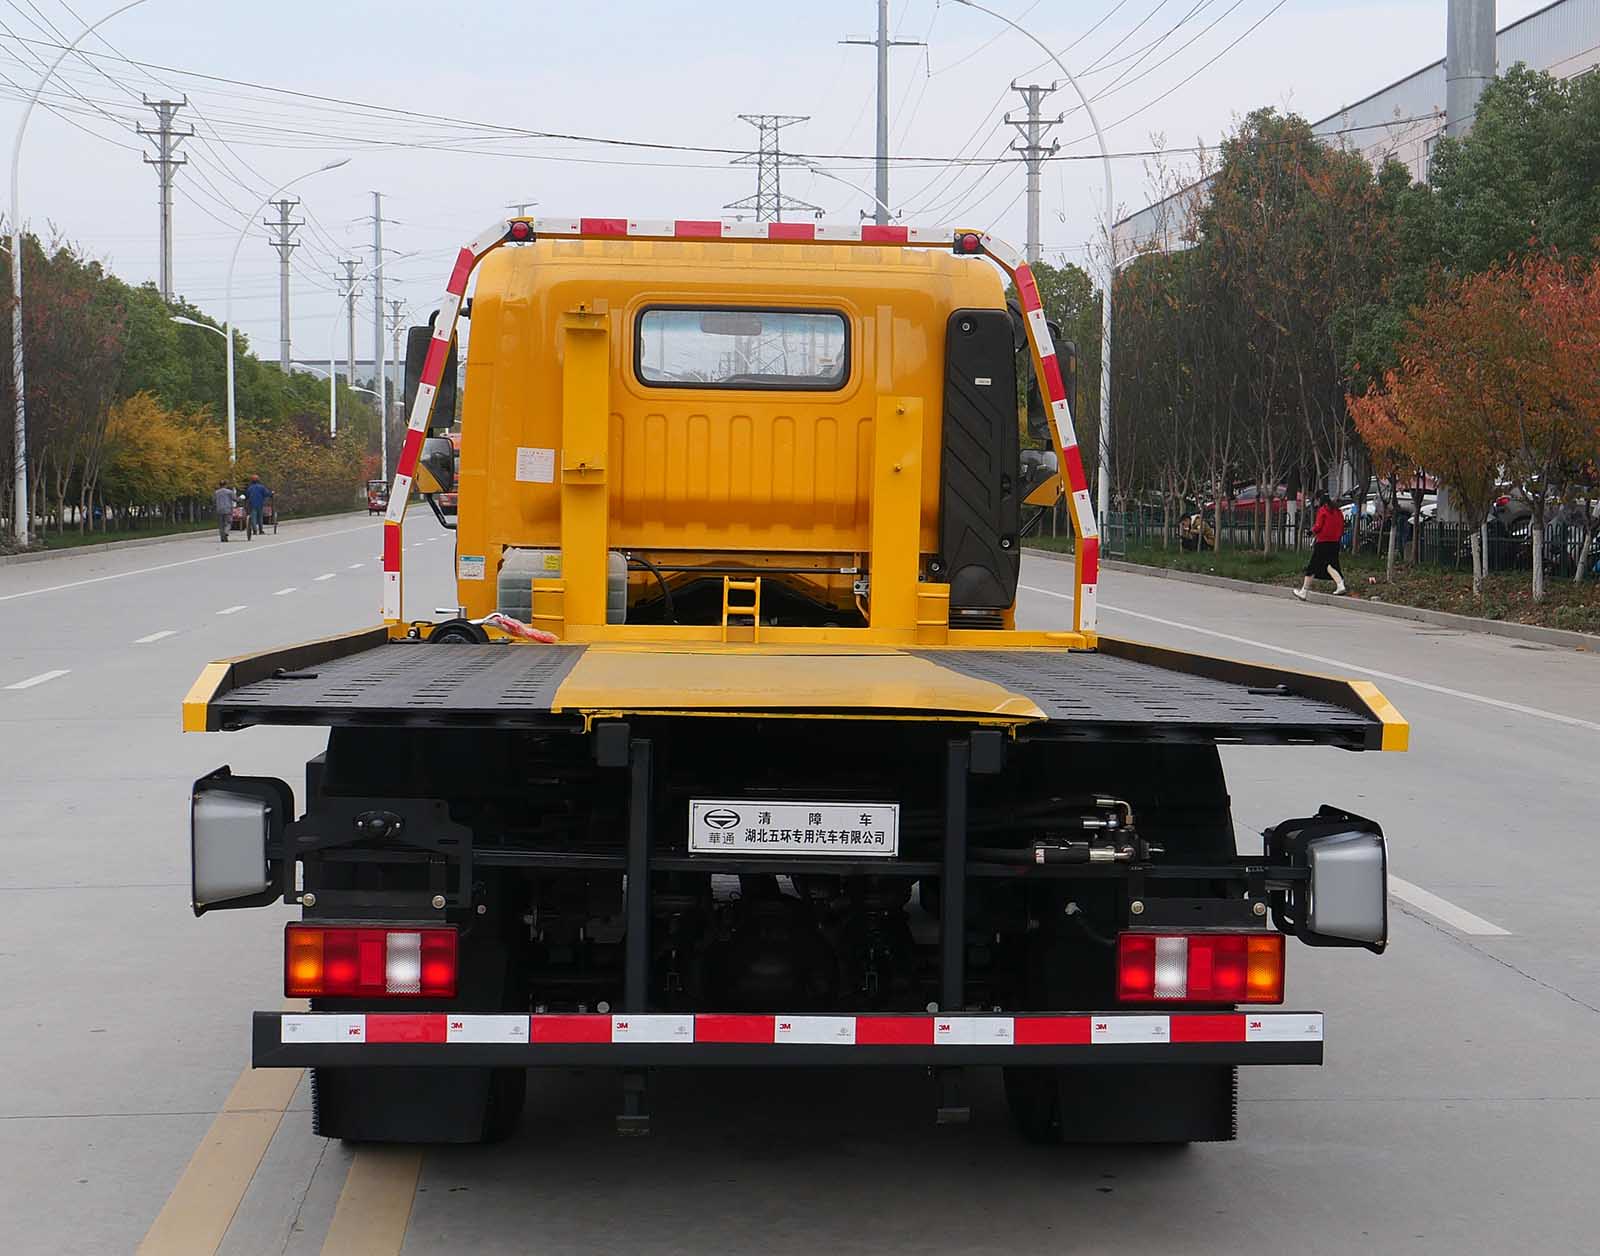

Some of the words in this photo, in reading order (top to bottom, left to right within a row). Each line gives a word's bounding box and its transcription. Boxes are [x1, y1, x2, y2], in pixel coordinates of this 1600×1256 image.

[758, 811, 873, 826] 清障车
[708, 832, 735, 845] 華通
[744, 828, 886, 845] 湖北五环专用汽车有限公司
